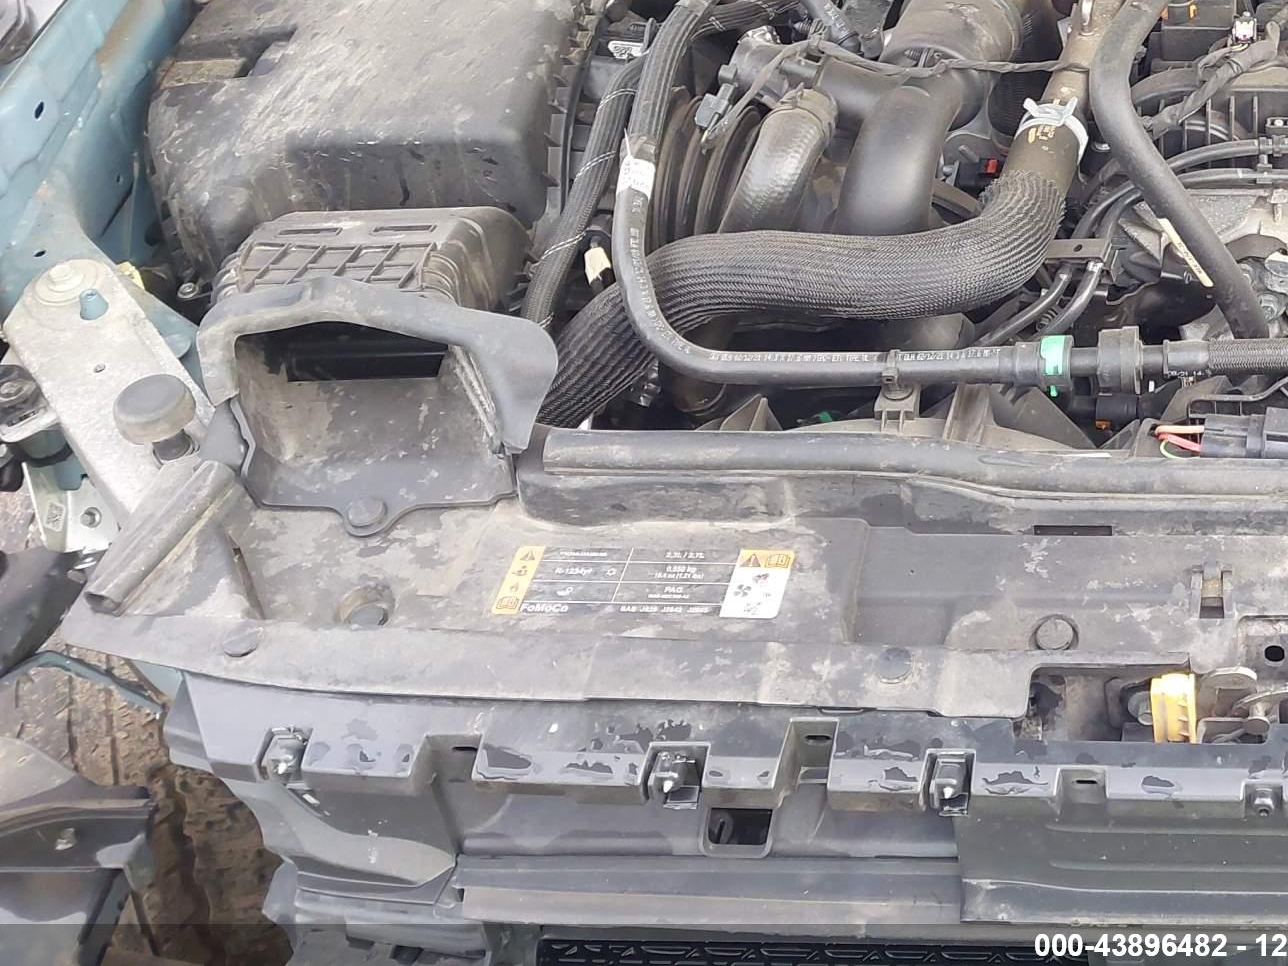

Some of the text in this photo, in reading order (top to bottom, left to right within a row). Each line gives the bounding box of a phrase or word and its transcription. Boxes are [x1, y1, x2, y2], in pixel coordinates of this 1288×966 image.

[554, 567, 593, 576] R-1234yf
[663, 586, 684, 594] PAG
[520, 603, 569, 613] FoMoCo
